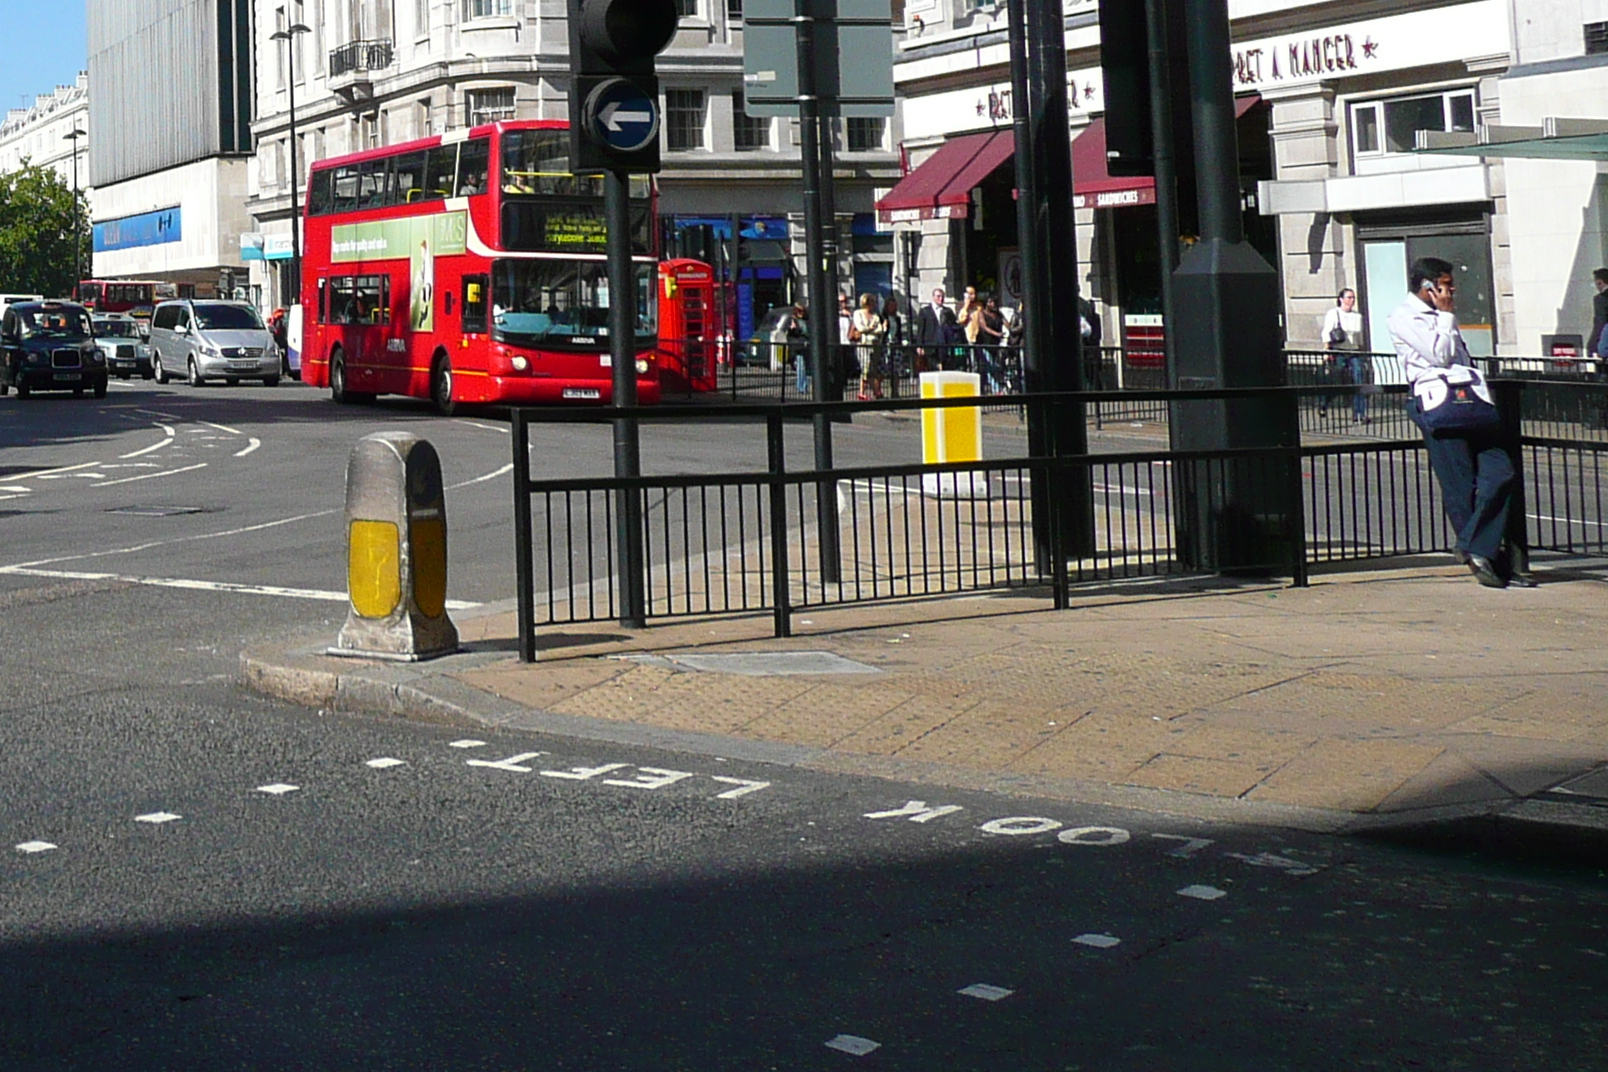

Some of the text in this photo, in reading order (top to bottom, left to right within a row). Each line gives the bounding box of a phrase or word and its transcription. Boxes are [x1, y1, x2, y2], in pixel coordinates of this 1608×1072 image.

[1272, 45, 1283, 80] A
[1289, 34, 1357, 77] MANGER
[1097, 191, 1139, 206] SANDWICHES
[466, 751, 1215, 859] LOOK LEFT
